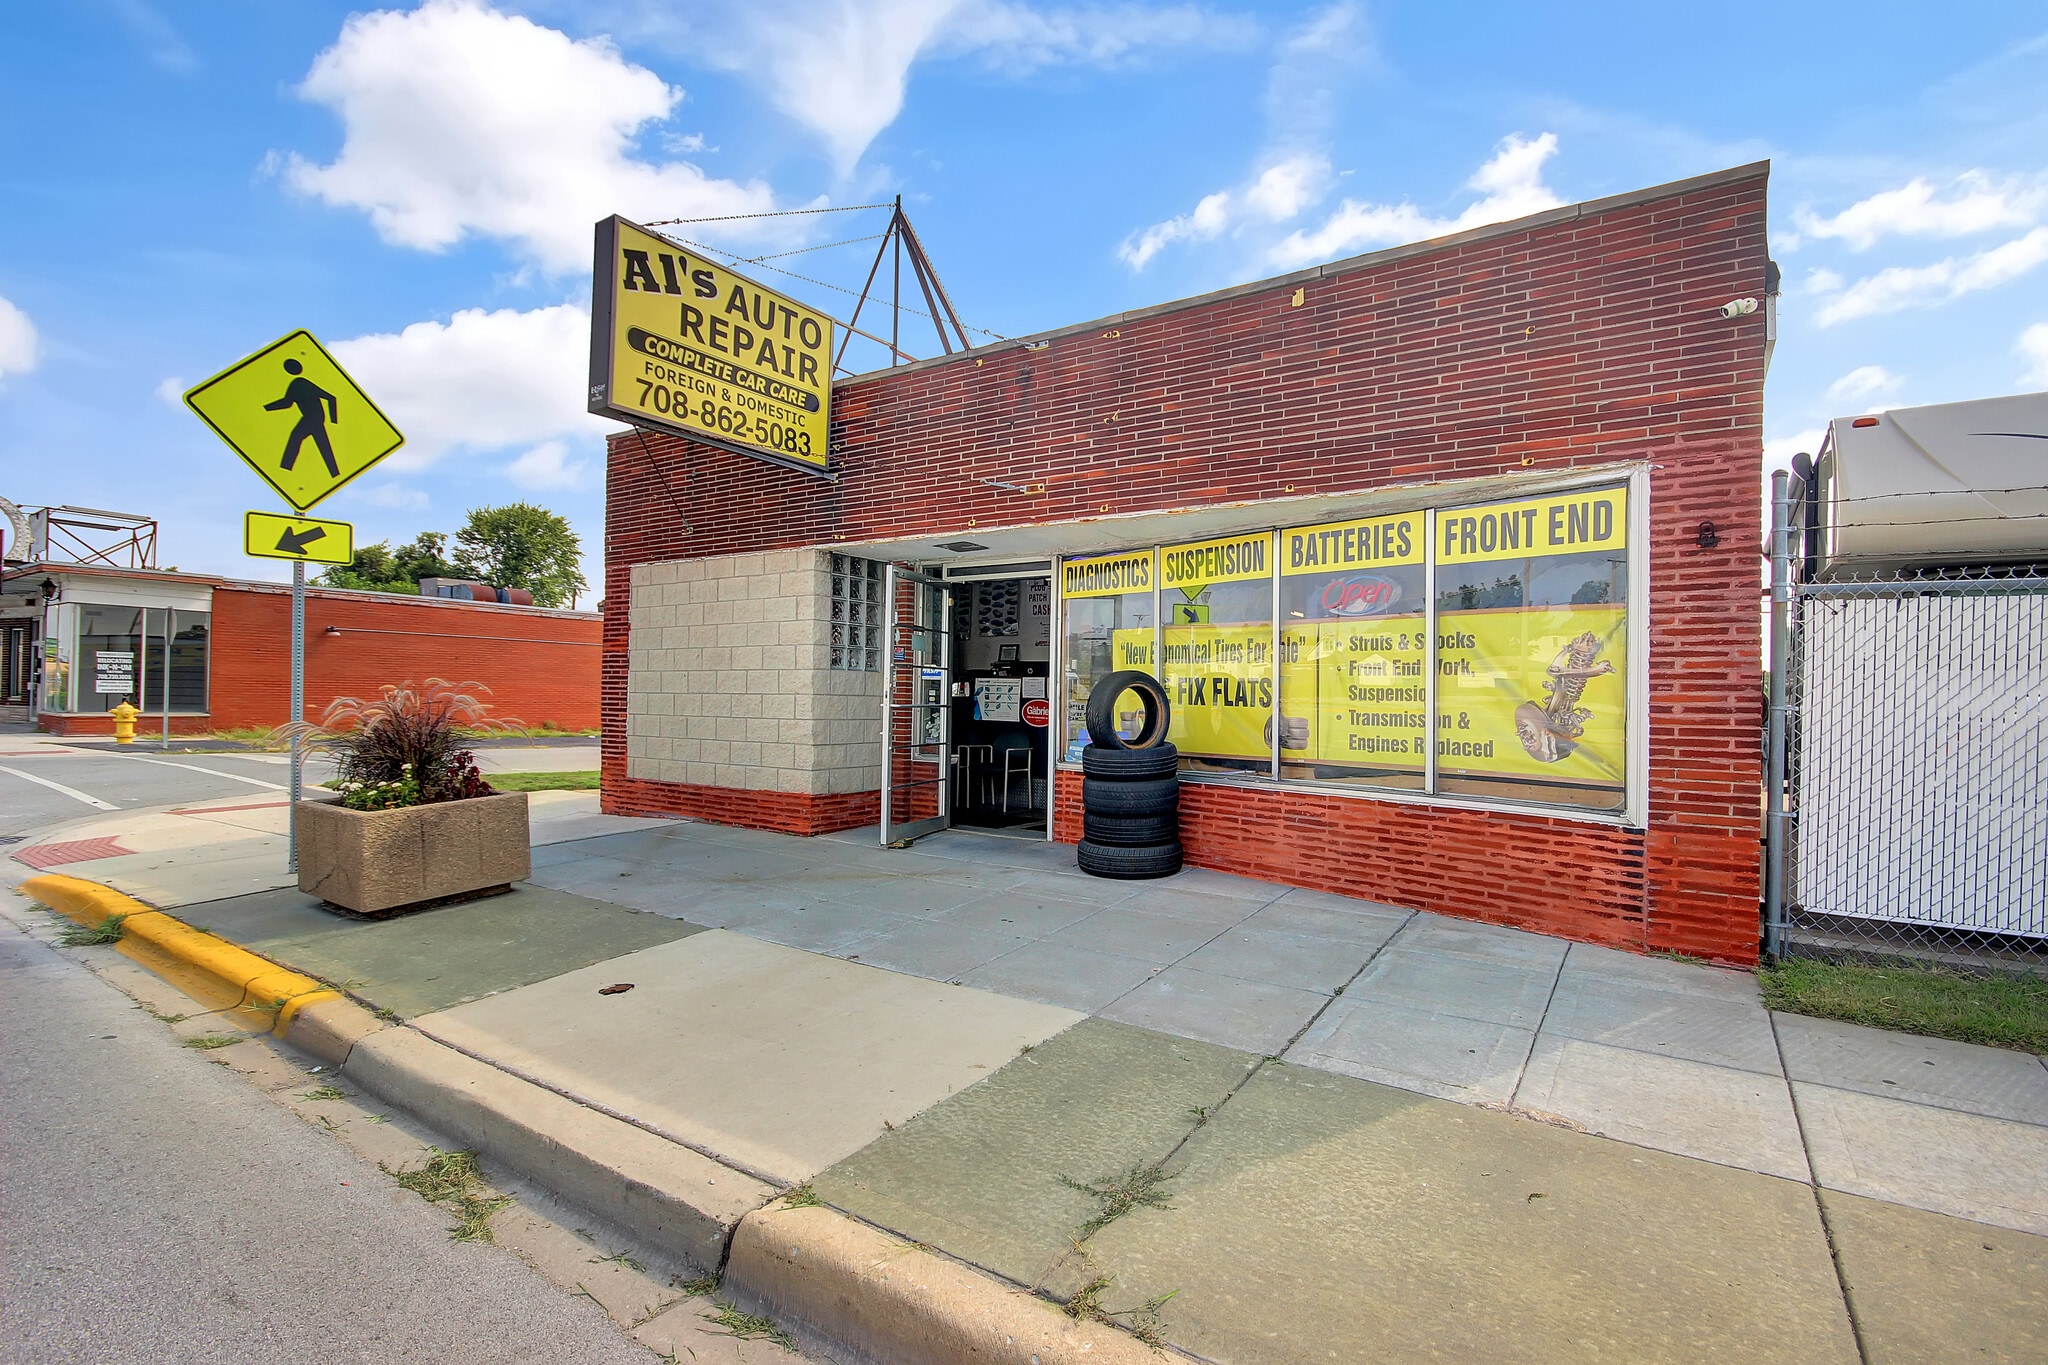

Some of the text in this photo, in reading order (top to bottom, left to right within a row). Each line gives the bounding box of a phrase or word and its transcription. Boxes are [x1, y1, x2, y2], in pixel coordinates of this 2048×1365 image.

[623, 248, 822, 349] Al's AUTO
[680, 302, 820, 388] REPAIR
[644, 336, 807, 408] COMPLETE CAR CARE
[645, 361, 806, 427] FOREIGN & DOMESTIC
[636, 377, 811, 457] 708-862-5083
[1444, 500, 1613, 556] FRONT END
[1291, 521, 1412, 568] BATTERIES
[1066, 557, 1149, 593] DIAGNOSTICS
[1166, 539, 1265, 582] SUSPENSION
[1029, 594, 1047, 602] PATCH
[1321, 580, 1392, 610] Open
[1150, 639, 1211, 665] Enomical
[1214, 639, 1242, 665] Tires
[1247, 638, 1266, 665] For
[1271, 636, 1305, 664] ale”
[1349, 631, 1475, 652] Struts & Socks
[1349, 657, 1475, 677] Front End ork,
[1177, 677, 1206, 706] FIX
[1213, 677, 1272, 708] FLATS
[1348, 685, 1426, 703] Suspensio
[1026, 705, 1048, 716] Gabrie
[1349, 710, 1470, 729] Transmissn &
[1349, 734, 1494, 758] Engines Rplaced
